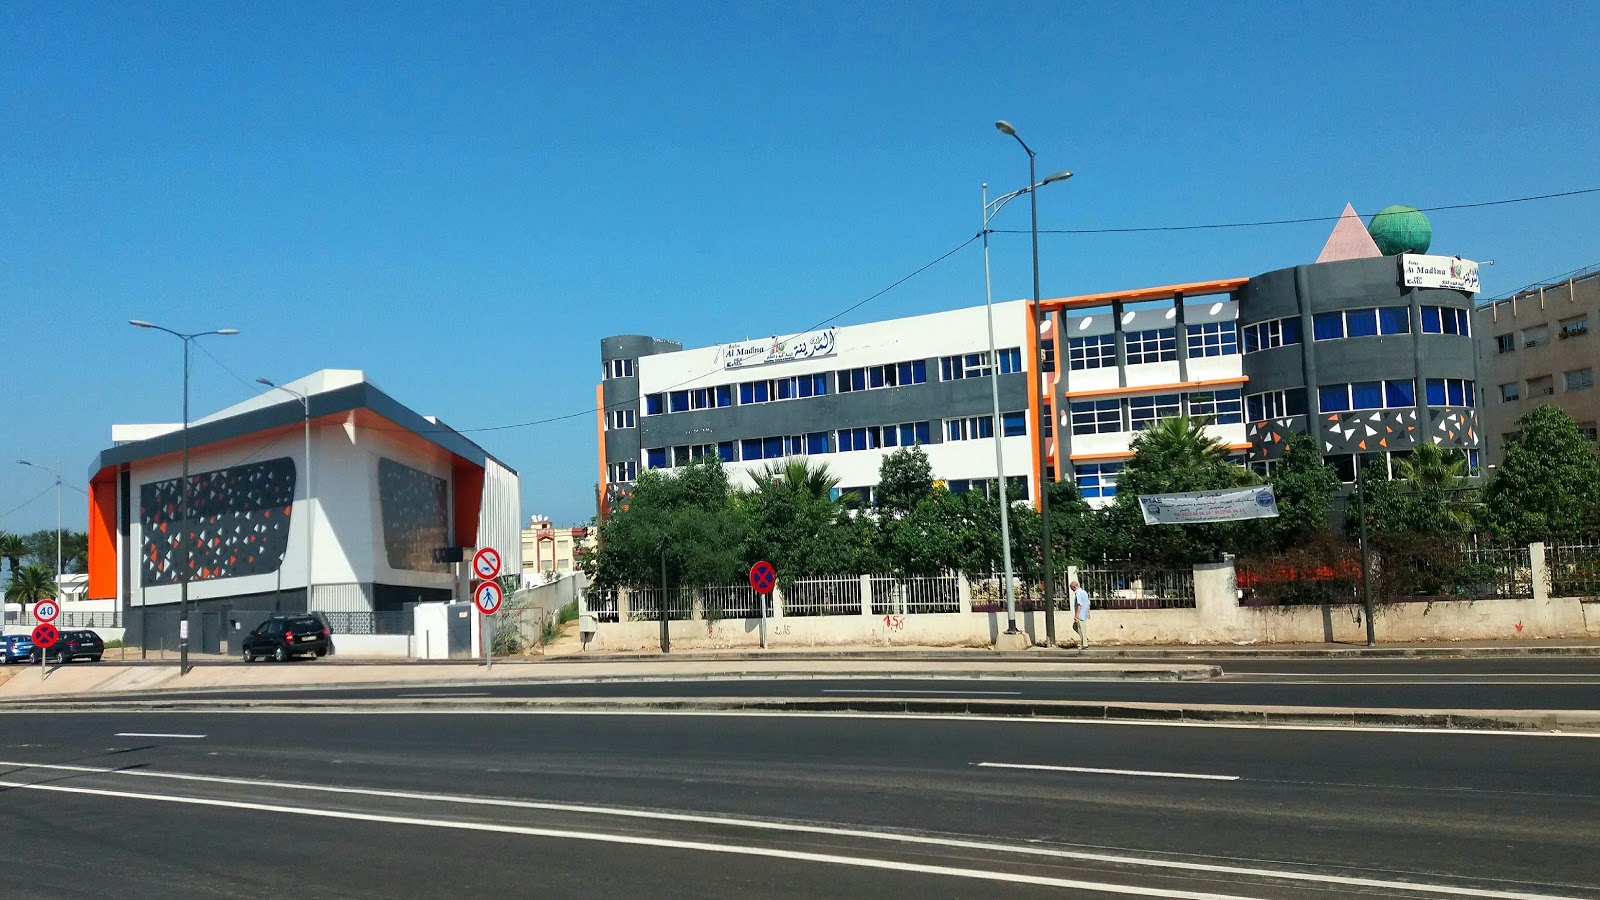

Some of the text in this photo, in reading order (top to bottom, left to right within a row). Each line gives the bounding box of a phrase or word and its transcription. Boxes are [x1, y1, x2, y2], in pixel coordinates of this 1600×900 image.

[1416, 266, 1446, 275] Madina
[736, 346, 764, 355] Madina
[39, 606, 54, 616] 40
